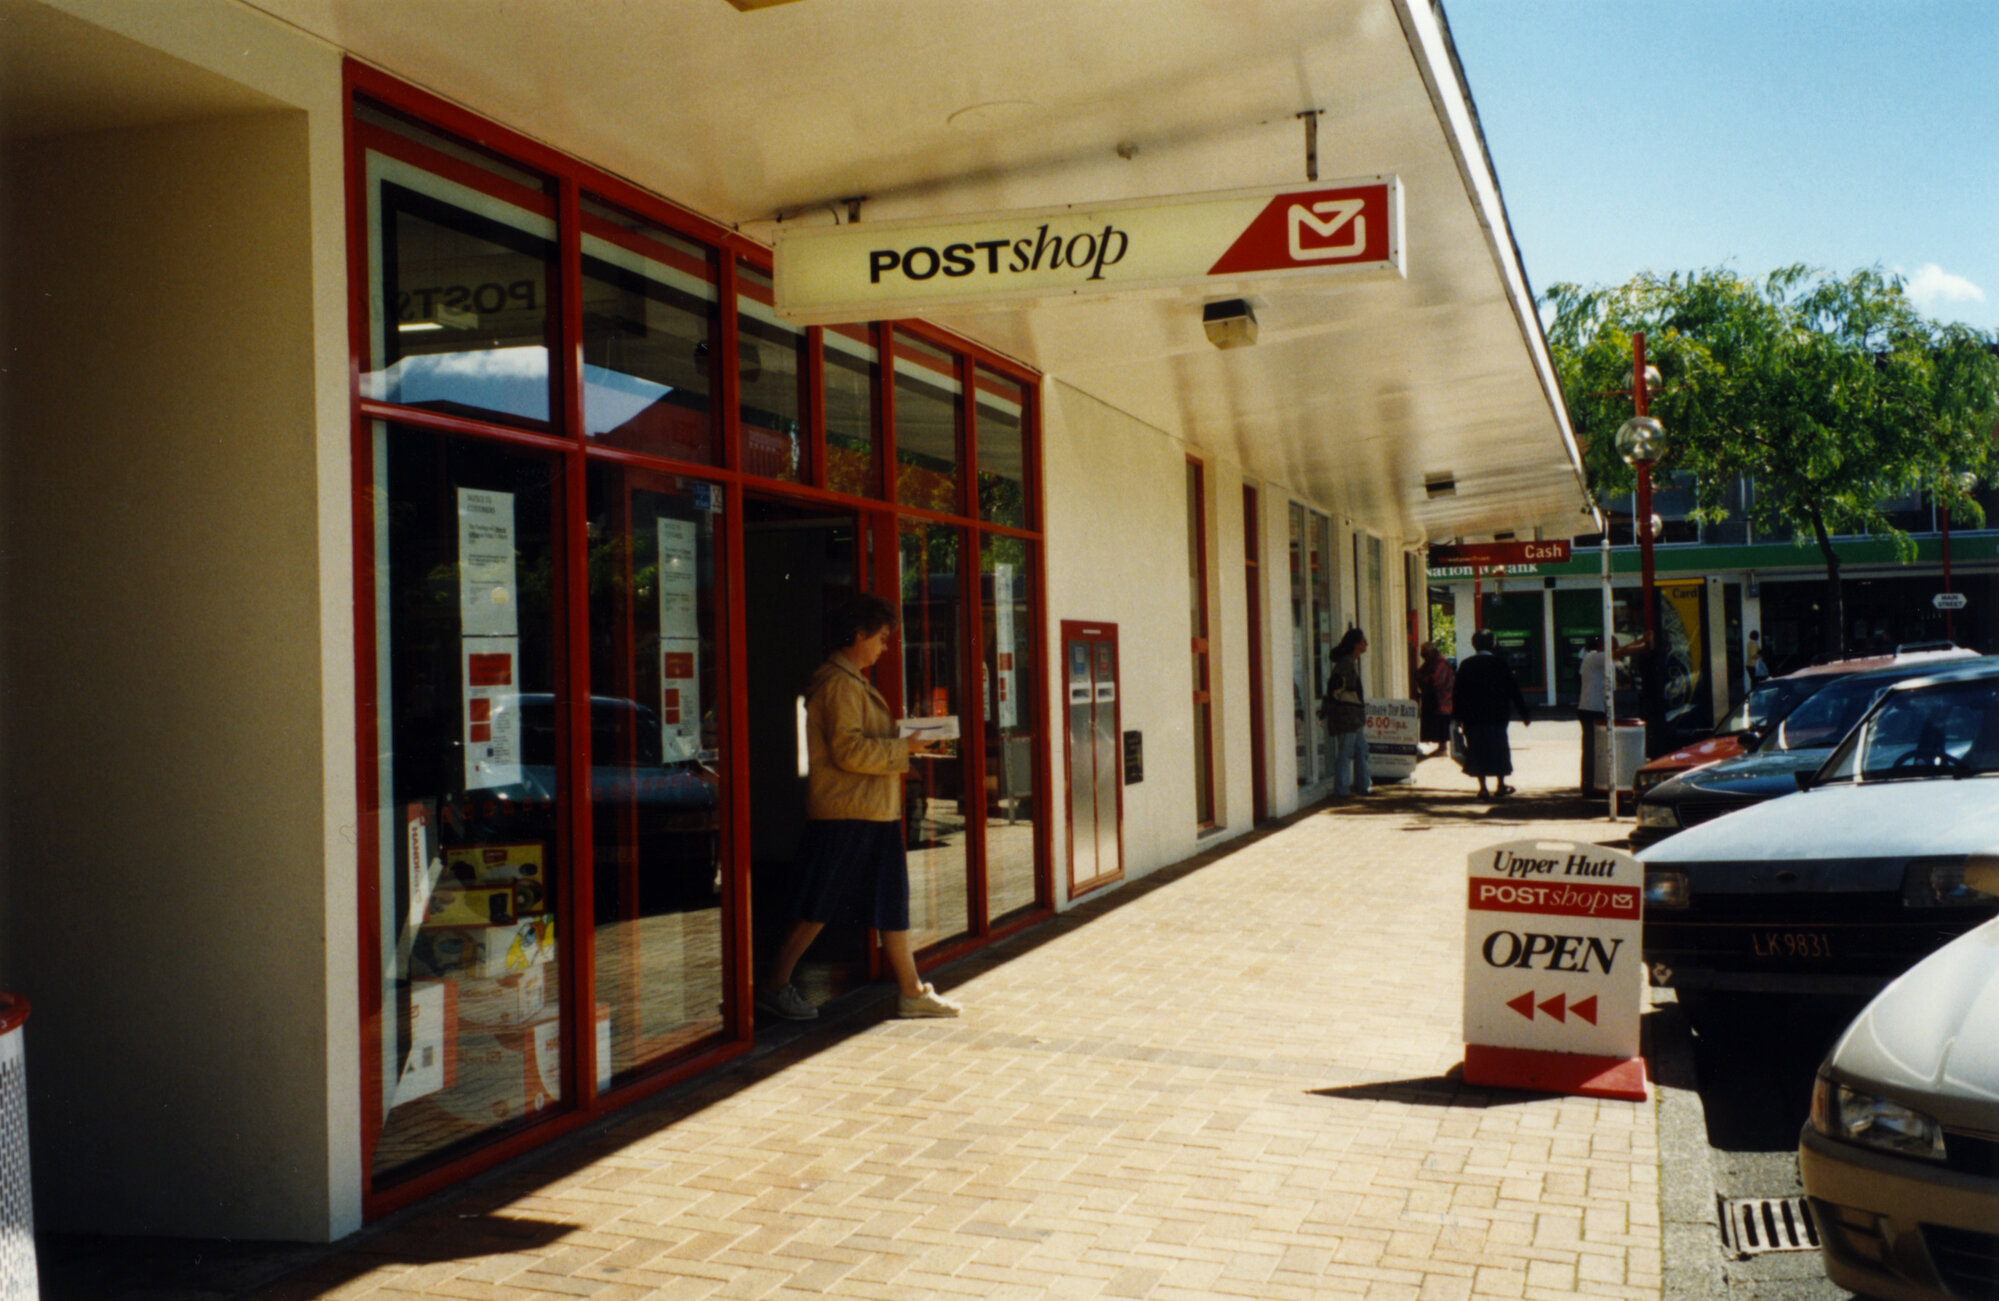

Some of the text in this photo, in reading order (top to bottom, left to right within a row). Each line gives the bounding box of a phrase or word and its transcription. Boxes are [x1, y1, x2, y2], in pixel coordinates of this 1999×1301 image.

[869, 224, 1129, 284] POSTshop
[1524, 543, 1562, 559] Cash
[1672, 588, 1698, 598] Card
[1493, 851, 1616, 878] Upper Hutt
[1480, 884, 1609, 914] POSTshop
[1482, 930, 1623, 975] OPEN
